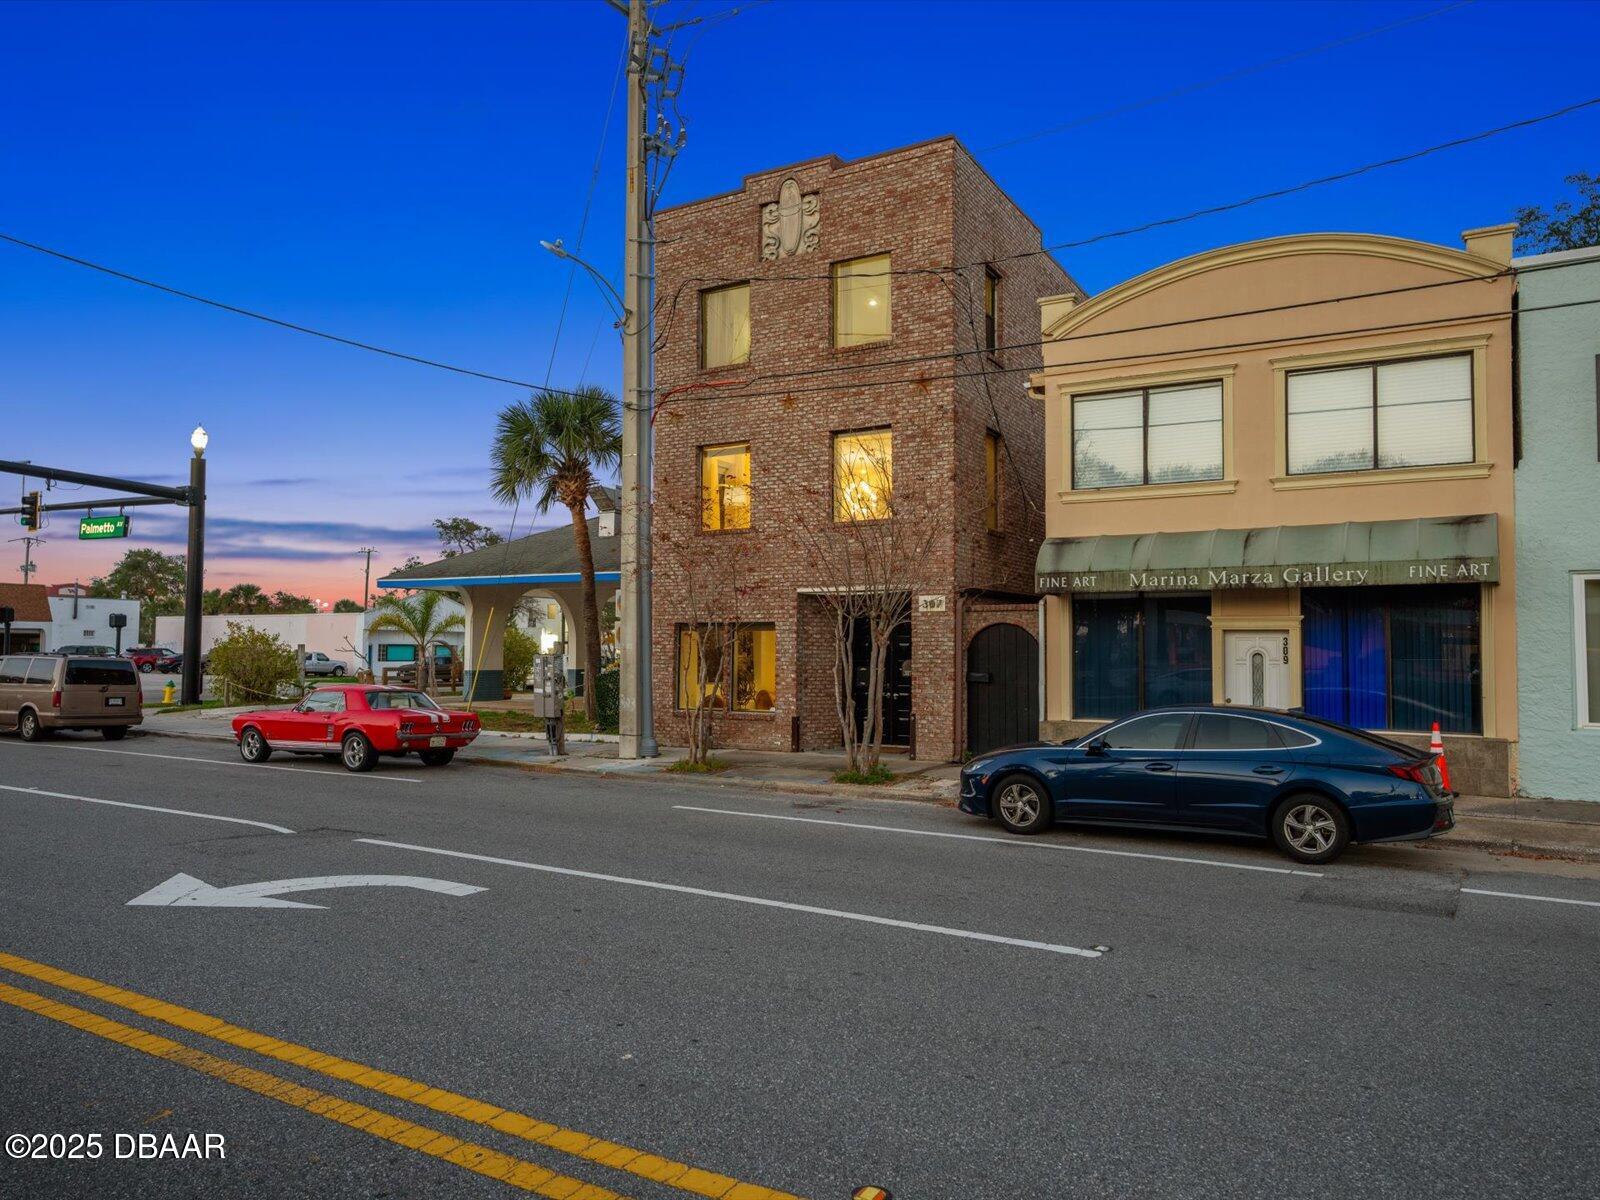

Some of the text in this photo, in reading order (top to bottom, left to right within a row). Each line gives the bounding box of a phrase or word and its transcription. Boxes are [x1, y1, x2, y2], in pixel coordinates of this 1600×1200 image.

[80, 522, 115, 535] Palmetto
[1129, 566, 1369, 588] Marina Marza Gallery
[1409, 563, 1490, 578] FINE ART
[1039, 576, 1097, 588] FINE ART
